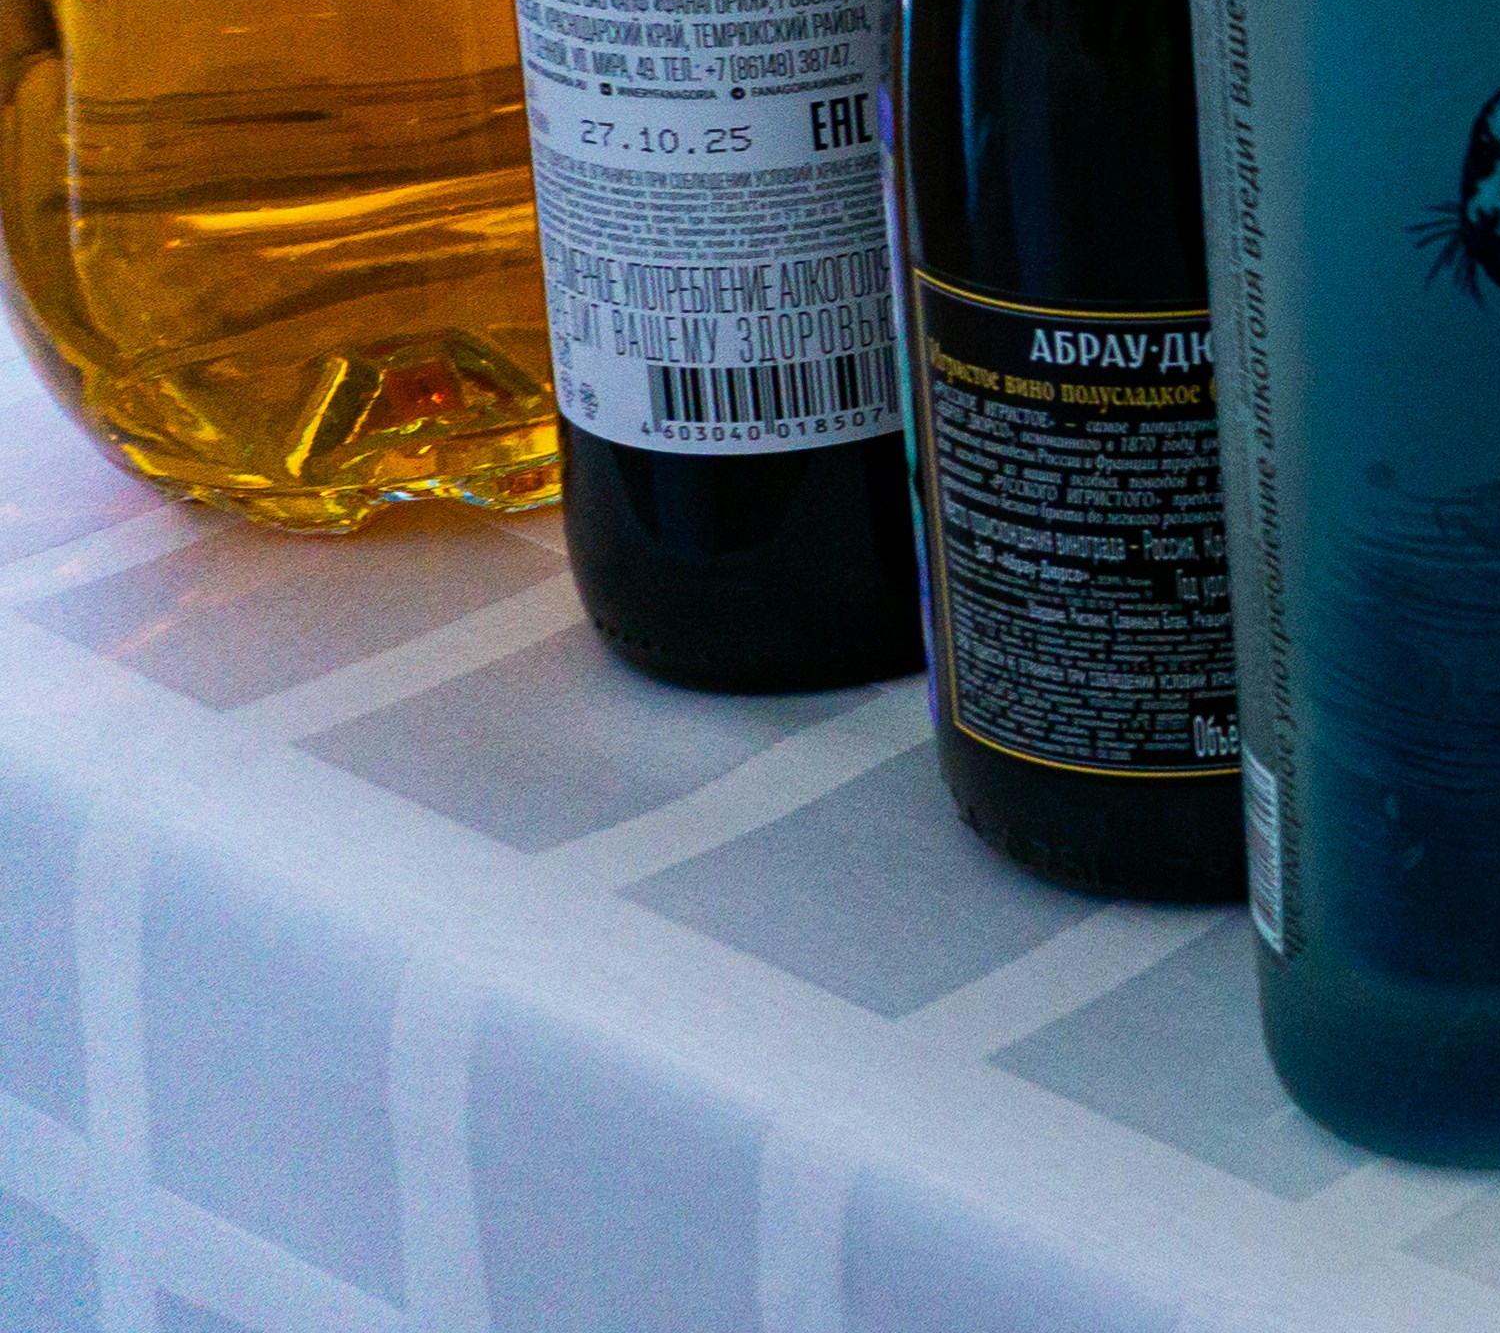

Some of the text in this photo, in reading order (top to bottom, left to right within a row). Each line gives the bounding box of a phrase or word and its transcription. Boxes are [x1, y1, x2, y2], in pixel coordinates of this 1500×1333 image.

[704, 55, 726, 82] +7
[580, 118, 753, 156] 27.10.25
[1231, 114, 1266, 263] вредит
[611, 307, 719, 365] ВАШЕМУ
[1003, 373, 1055, 402] вино
[1059, 382, 1201, 415] полусладкое
[662, 422, 763, 443] 603040
[776, 406, 885, 440] 018507
[1120, 435, 1157, 453] 1870
